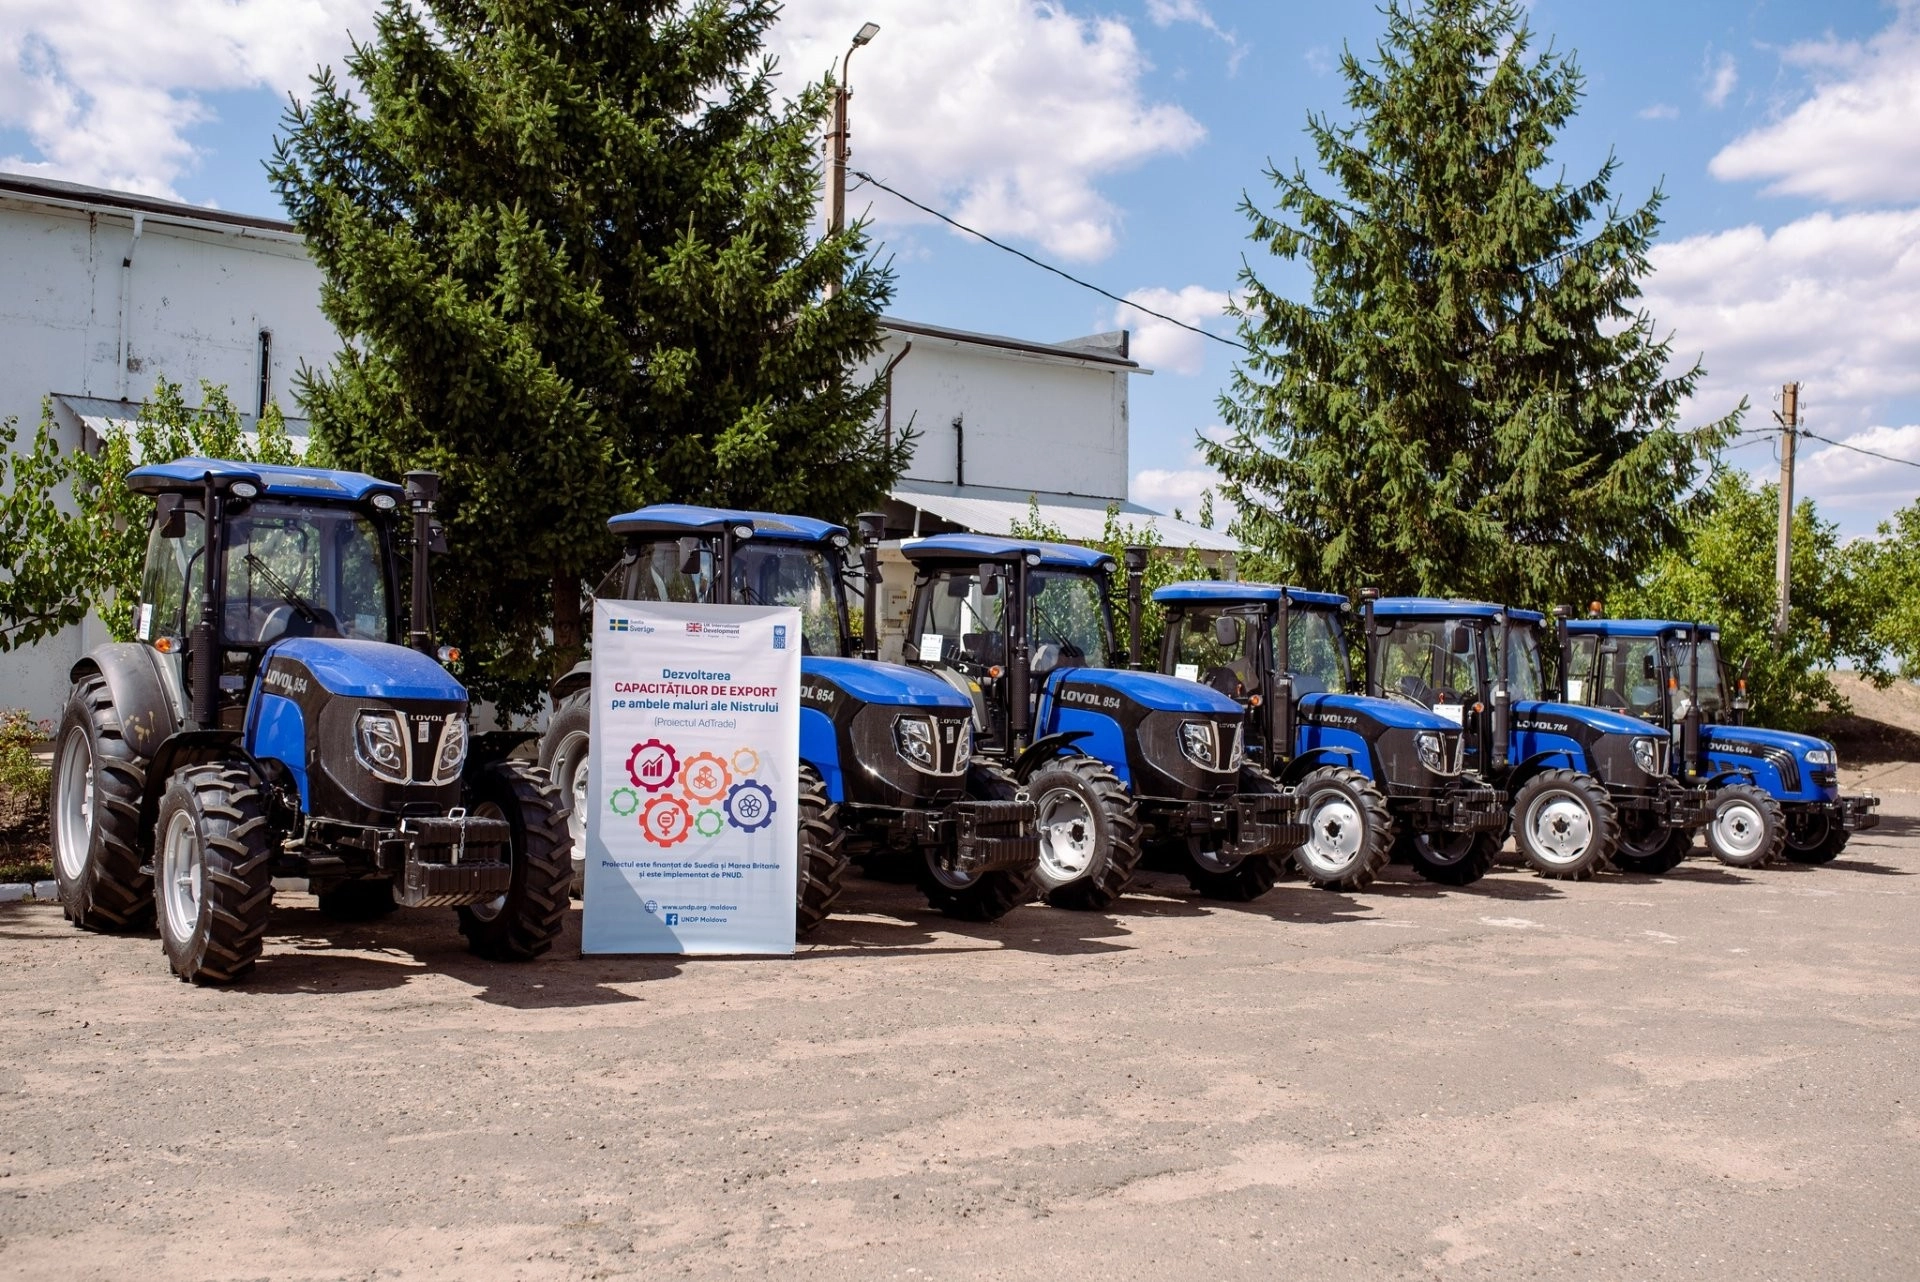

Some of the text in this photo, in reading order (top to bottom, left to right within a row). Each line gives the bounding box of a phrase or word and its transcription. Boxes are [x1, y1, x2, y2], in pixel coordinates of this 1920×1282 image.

[630, 625, 654, 634] Sverige
[662, 668, 731, 681] Dezvoltarea
[266, 668, 308, 694] LOVOL 854
[711, 686, 727, 696] DE
[730, 686, 778, 697] EXPORT
[816, 688, 834, 702] 854
[612, 698, 779, 712] pe ambele maluri ale Nistrului
[1060, 690, 1120, 708] LOVOL 854
[654, 716, 736, 730] (Proiectul AdTrade)
[1308, 714, 1343, 723] LOVOL
[1517, 720, 1552, 730] LOVOL
[652, 862, 681, 870] finanțat
[663, 871, 709, 879] implementat
